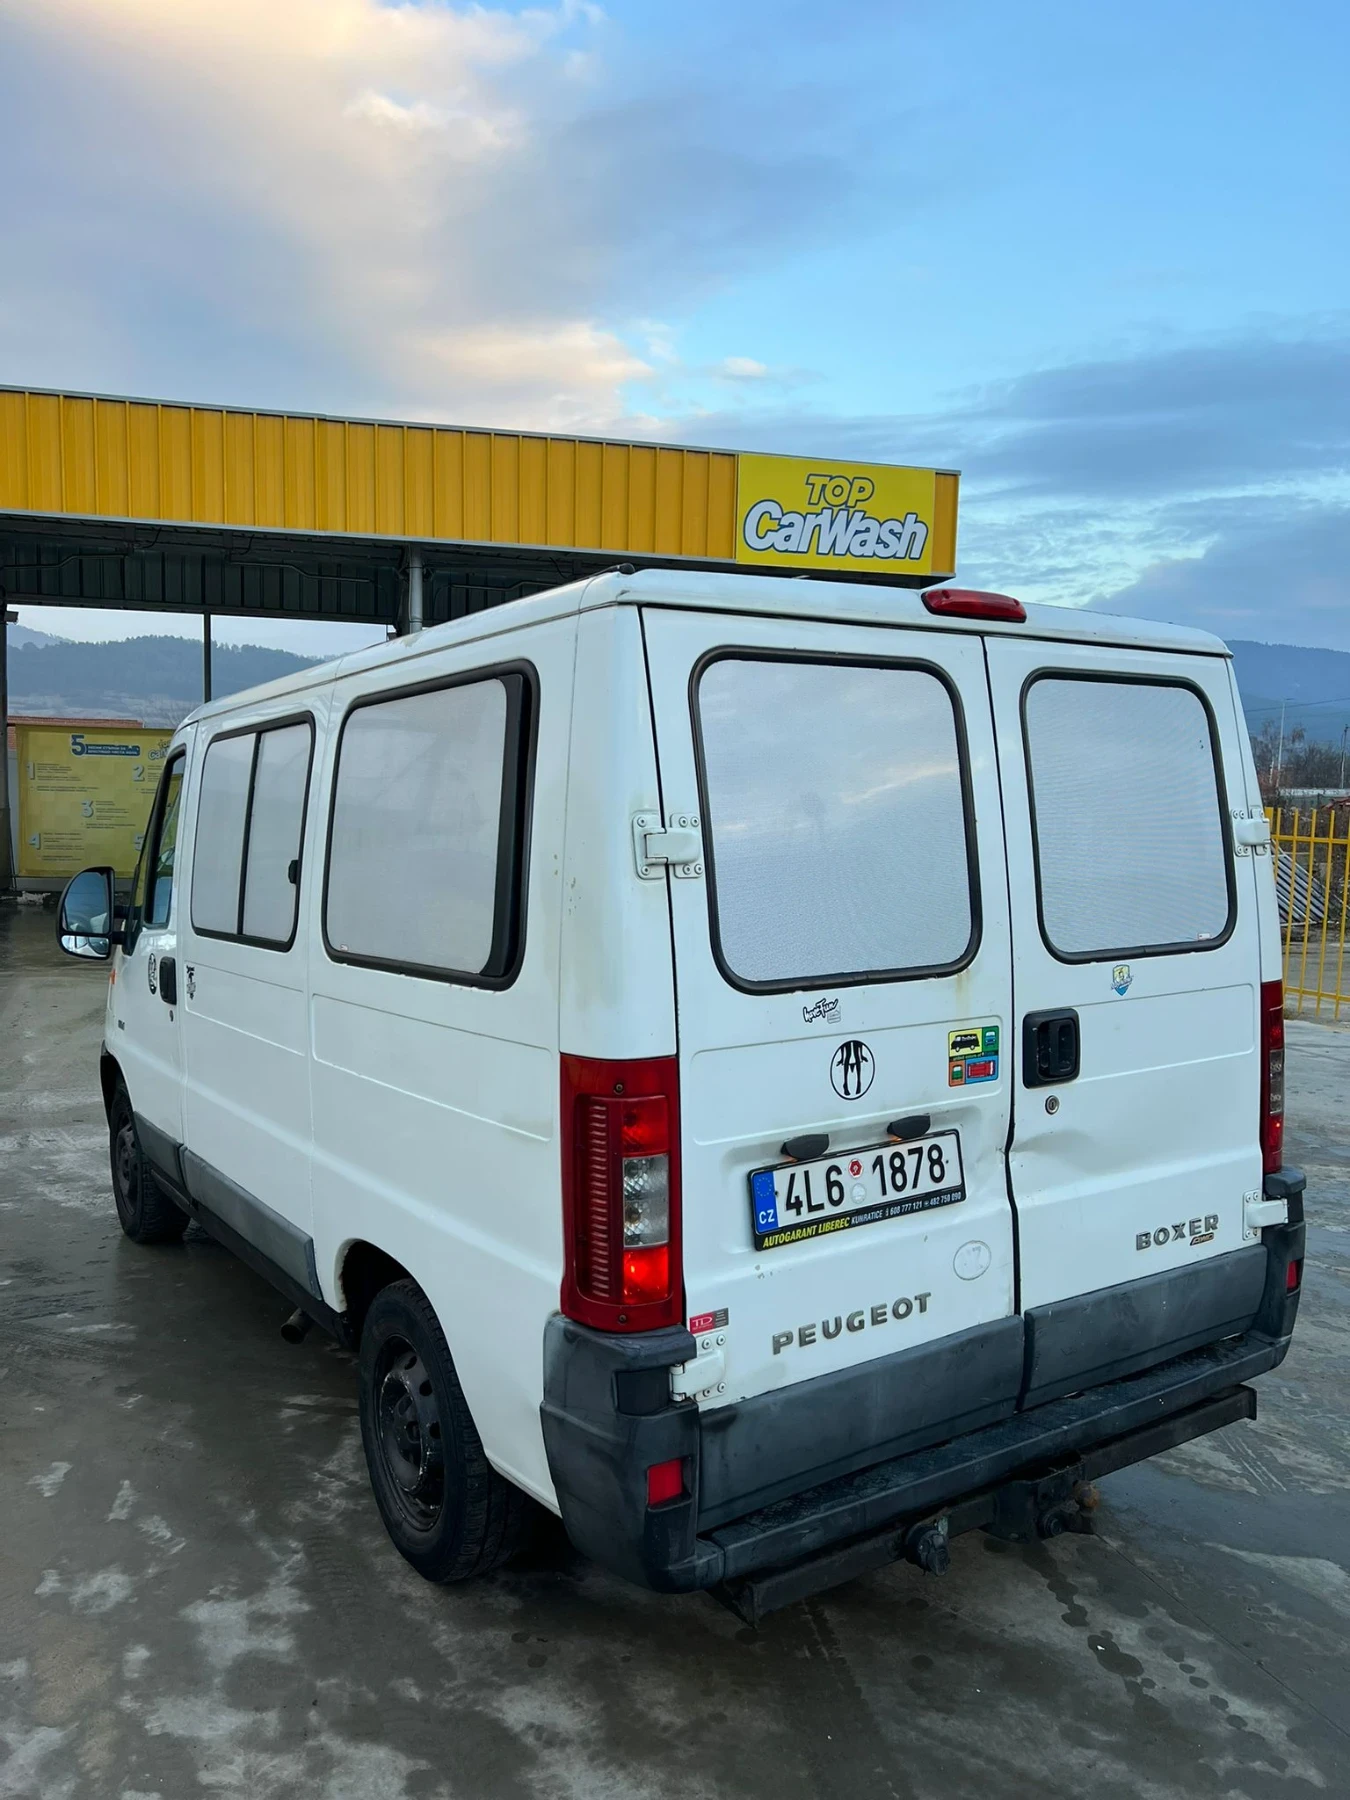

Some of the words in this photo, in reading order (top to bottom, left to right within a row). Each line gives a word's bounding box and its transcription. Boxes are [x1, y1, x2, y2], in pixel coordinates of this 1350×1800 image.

[805, 473, 874, 508] TOP
[743, 500, 928, 560] CarWash
[71, 735, 86, 756] 5
[27, 762, 35, 780] 1
[132, 765, 145, 782] 2
[81, 800, 94, 818] 3
[28, 833, 41, 850] 4
[785, 1164, 845, 1216] 4L6
[872, 1143, 945, 1197] 1878
[759, 1209, 775, 1224] CZ
[763, 1225, 817, 1248] AUTOGARANT
[818, 1217, 850, 1234] LIBEREC
[901, 1202, 912, 1212] 777
[913, 1200, 922, 1210] 121
[1136, 1214, 1219, 1251] BOXER
[772, 1291, 932, 1355] PEUGEOT
